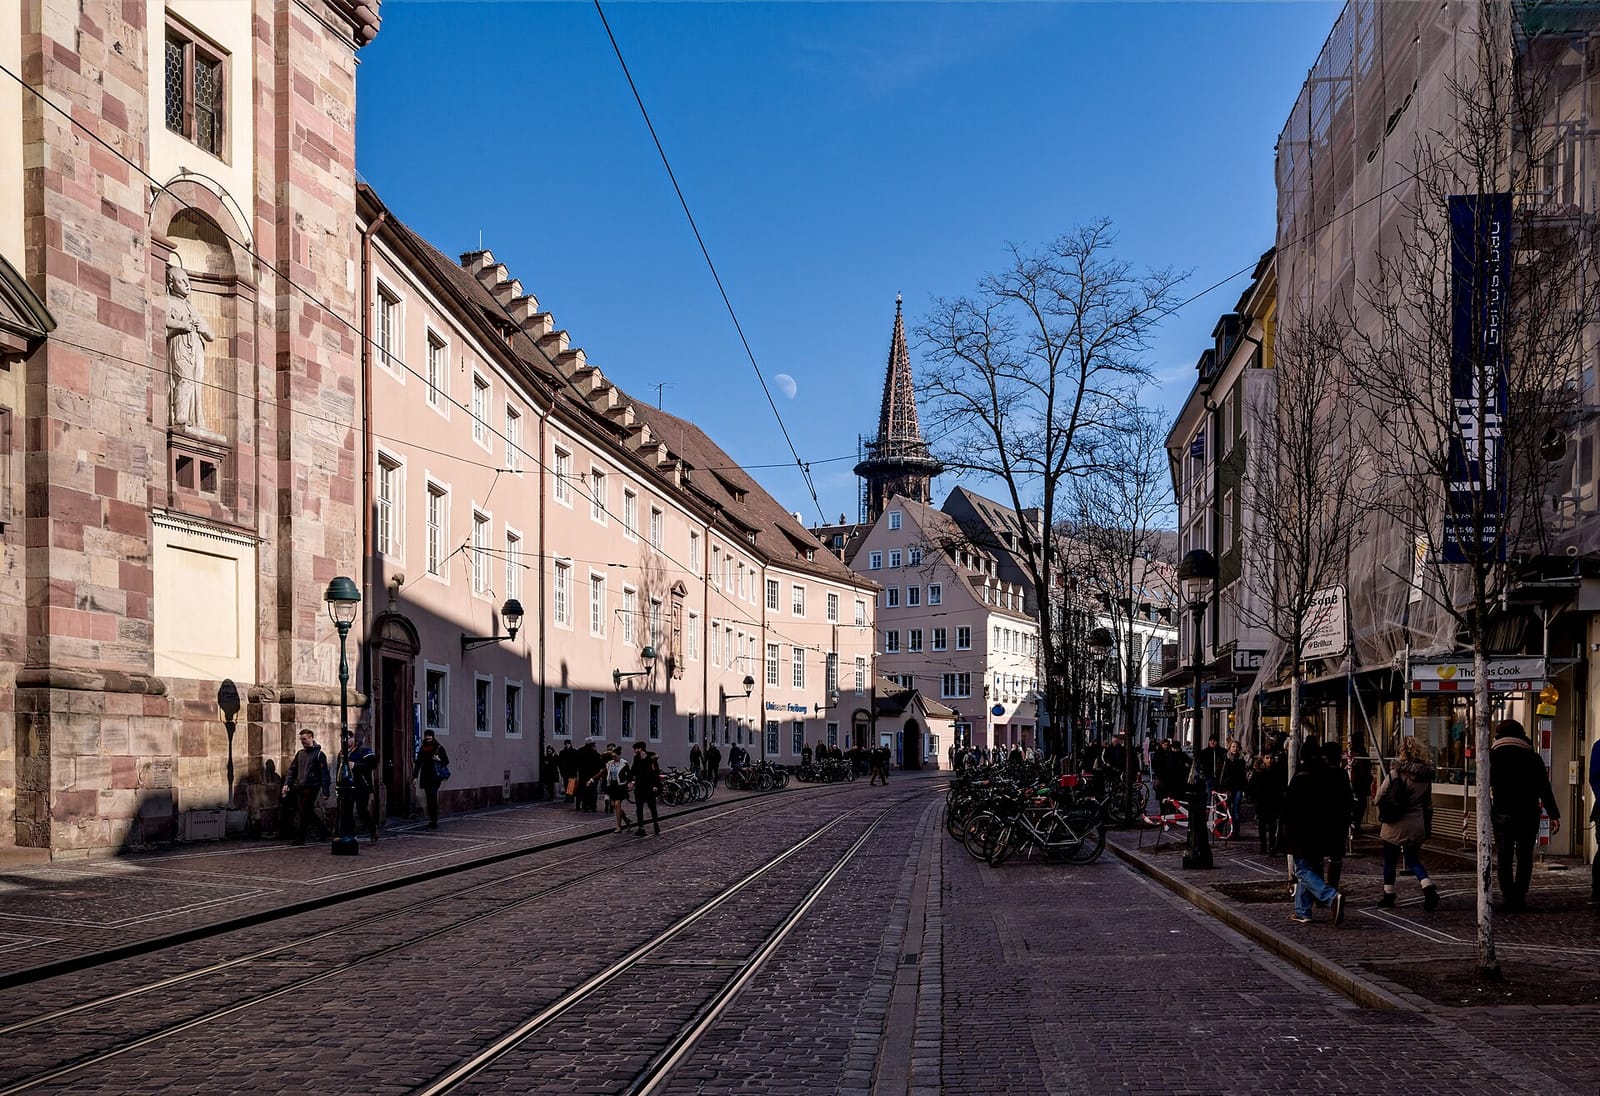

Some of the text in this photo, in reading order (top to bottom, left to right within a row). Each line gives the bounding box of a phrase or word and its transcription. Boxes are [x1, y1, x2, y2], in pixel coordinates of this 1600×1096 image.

[1313, 639, 1333, 648] Brillux
[1459, 665, 1521, 677] Thoas Cook
